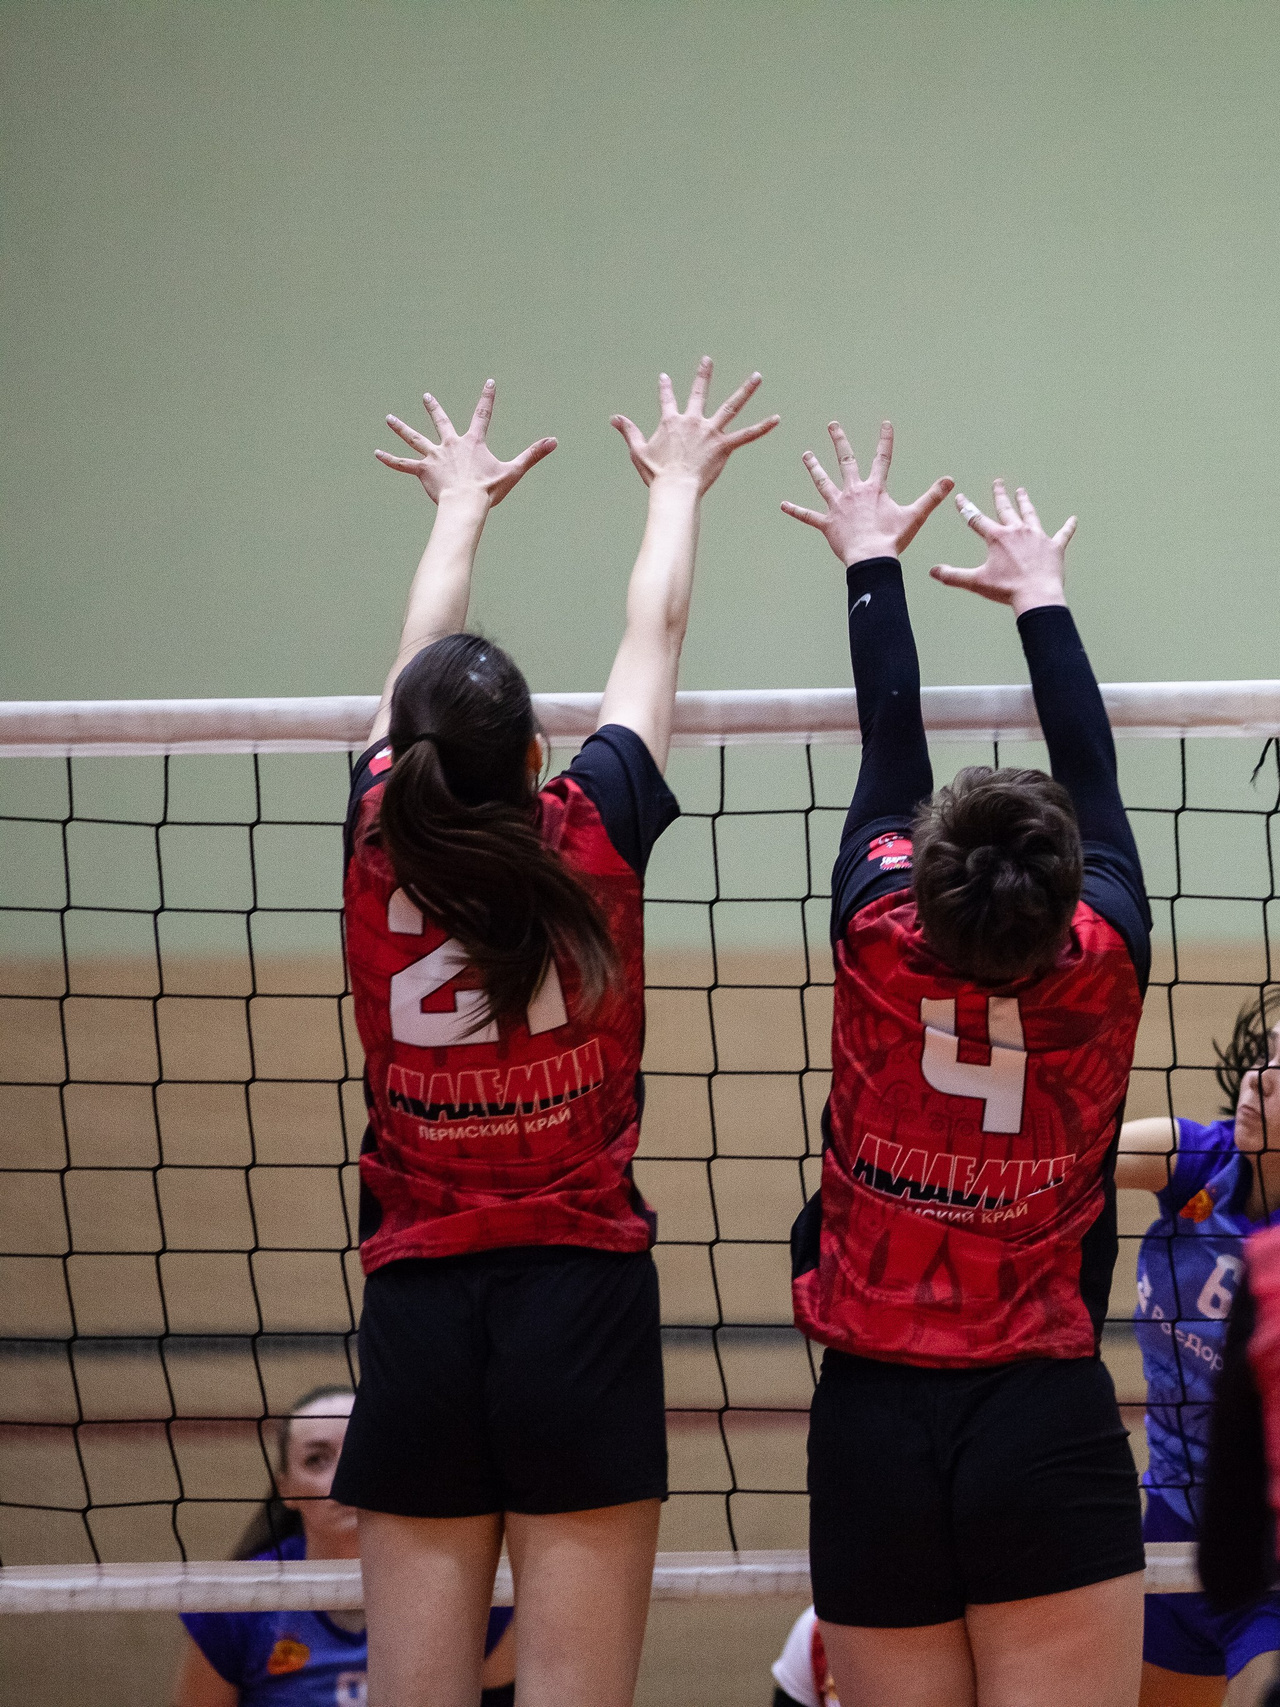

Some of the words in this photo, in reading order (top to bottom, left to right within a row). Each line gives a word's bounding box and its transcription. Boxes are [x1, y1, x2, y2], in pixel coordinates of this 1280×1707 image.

[920, 996, 1028, 1134] 4
[418, 1118, 520, 1142] ПЕРМСКИЙ
[524, 1106, 572, 1134] КРАЙ
[980, 1201, 1029, 1224] КРАЙ
[1196, 1254, 1243, 1320] 6
